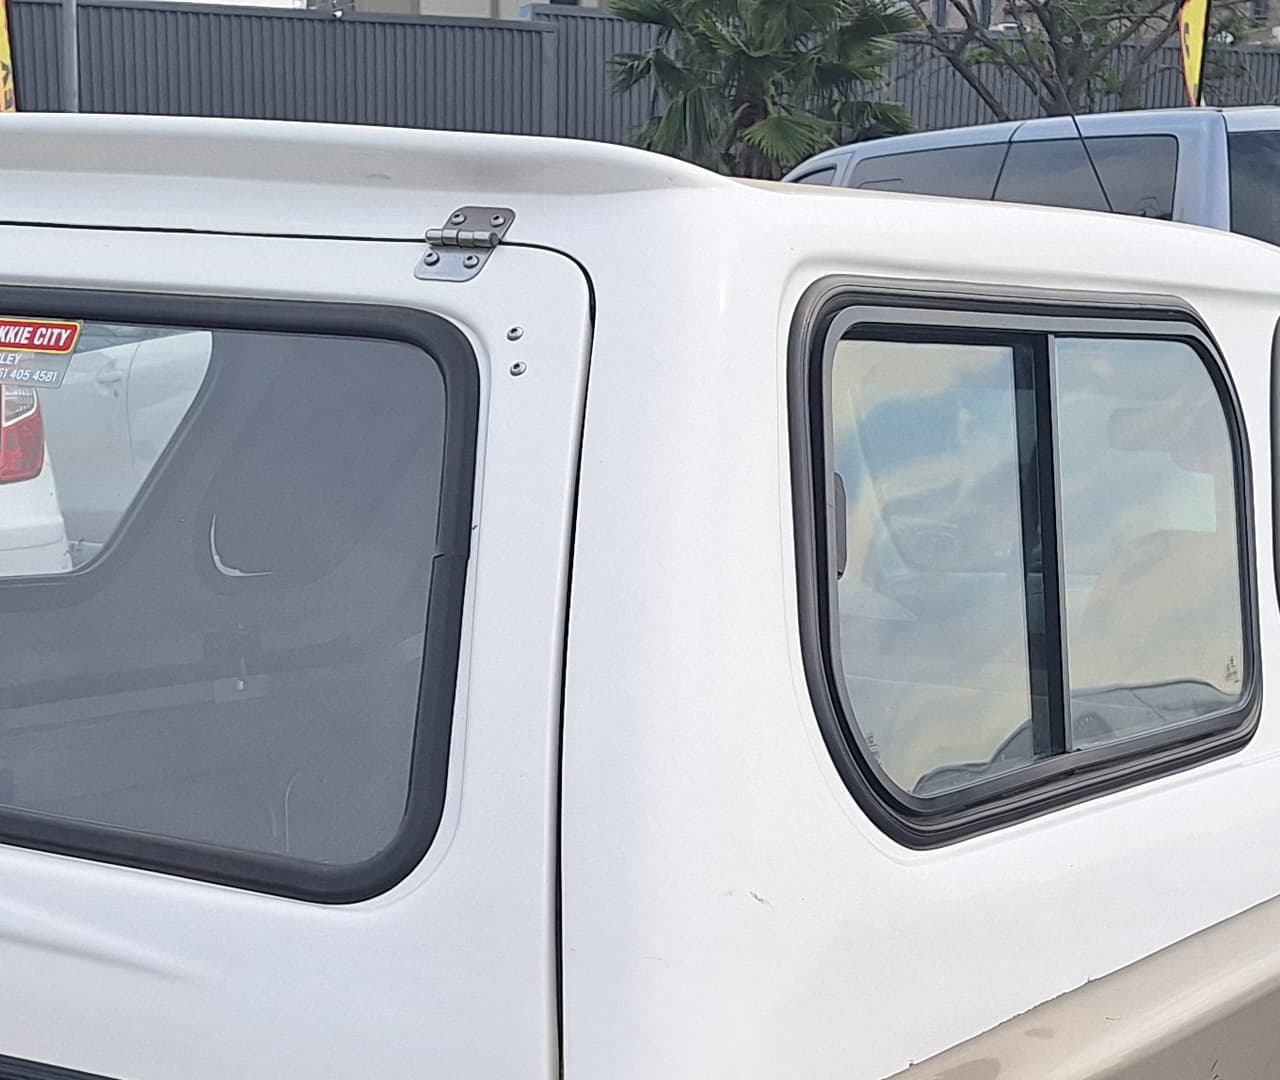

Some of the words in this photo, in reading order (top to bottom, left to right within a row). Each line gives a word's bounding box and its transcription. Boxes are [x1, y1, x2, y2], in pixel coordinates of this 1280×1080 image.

[33, 328, 72, 346] CITY
[9, 369, 31, 381] 405
[32, 370, 57, 383] 4581
